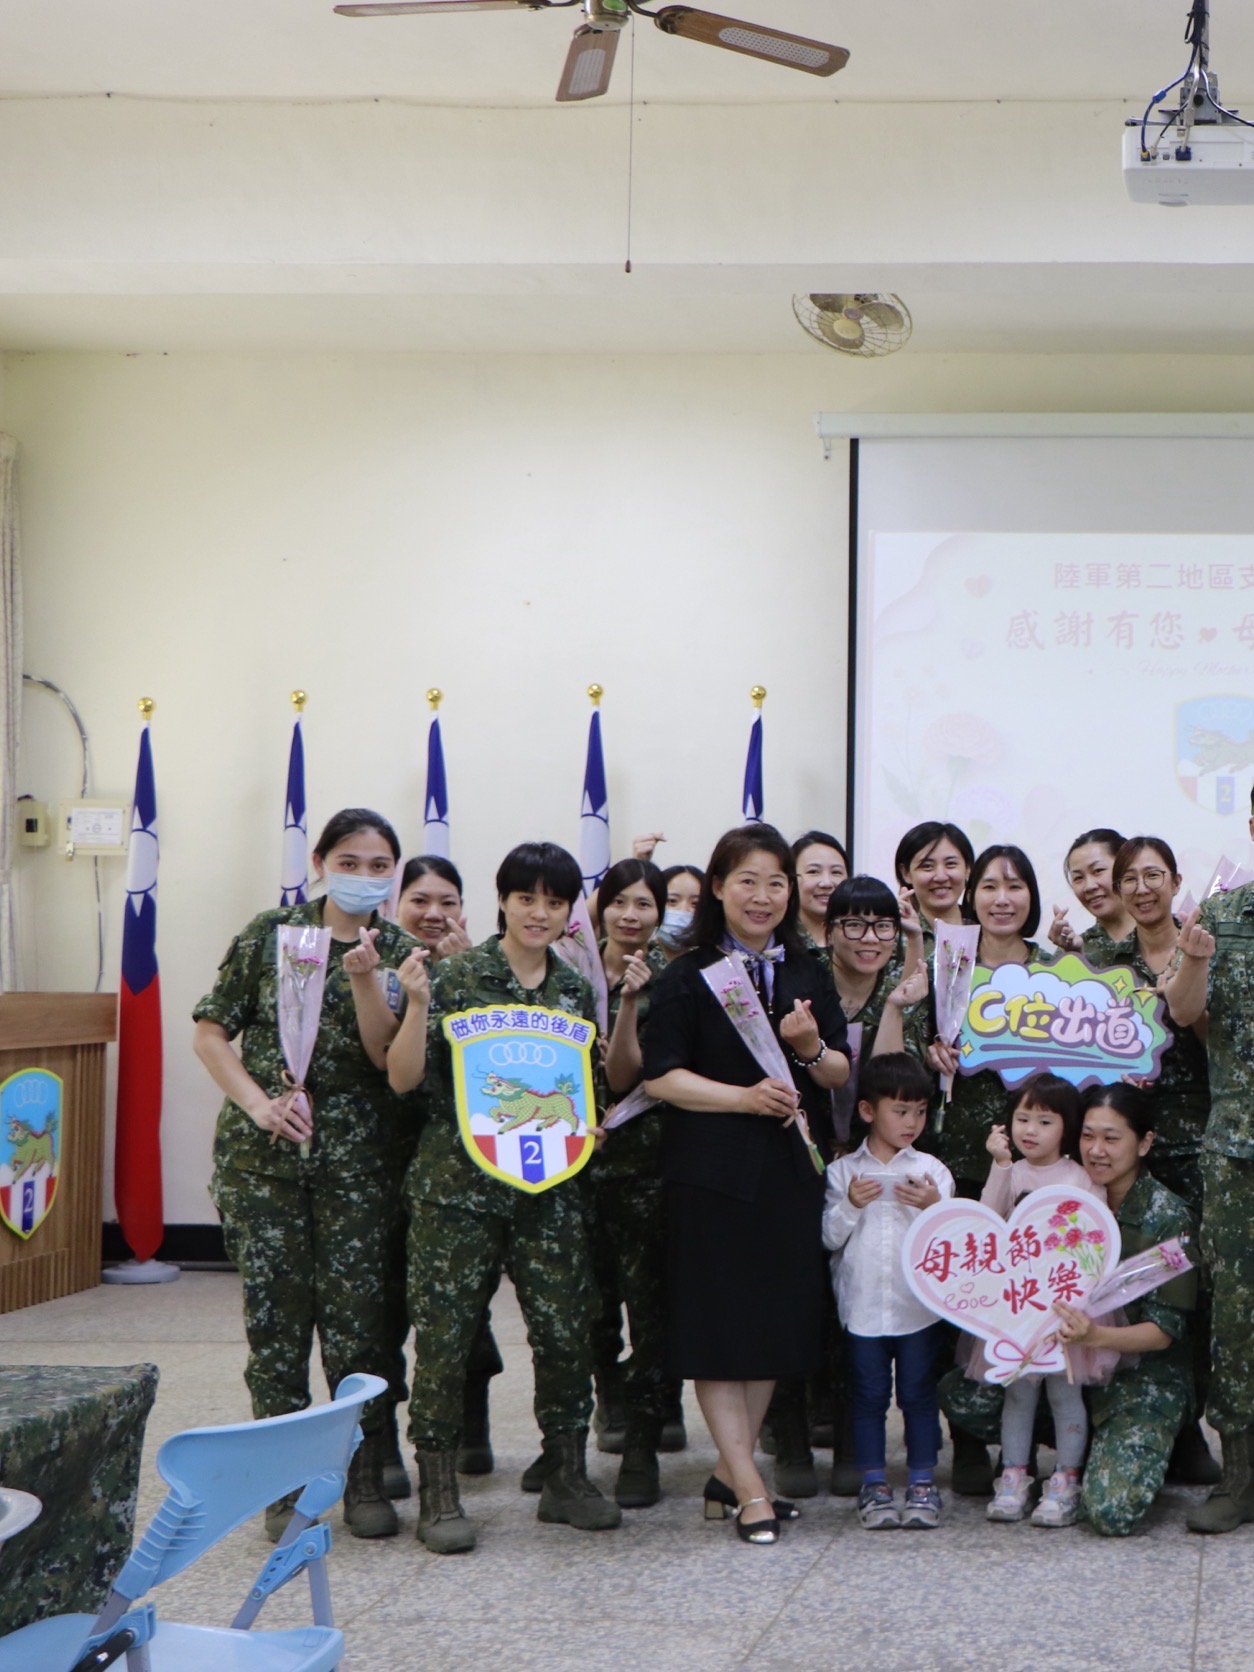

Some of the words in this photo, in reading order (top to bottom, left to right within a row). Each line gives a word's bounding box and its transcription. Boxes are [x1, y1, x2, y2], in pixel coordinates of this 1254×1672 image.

[1005, 608, 1186, 651] 感謝有您
[1136, 660, 1187, 678] Happy
[1219, 784, 1231, 803] 2
[451, 1009, 591, 1043] 做你永遠的後盾
[968, 990, 1143, 1057] C位出道
[523, 1141, 542, 1164] 2
[24, 1188, 34, 1212] 2
[914, 1225, 1042, 1283] 母親節
[1003, 1260, 1084, 1315] 快樂
